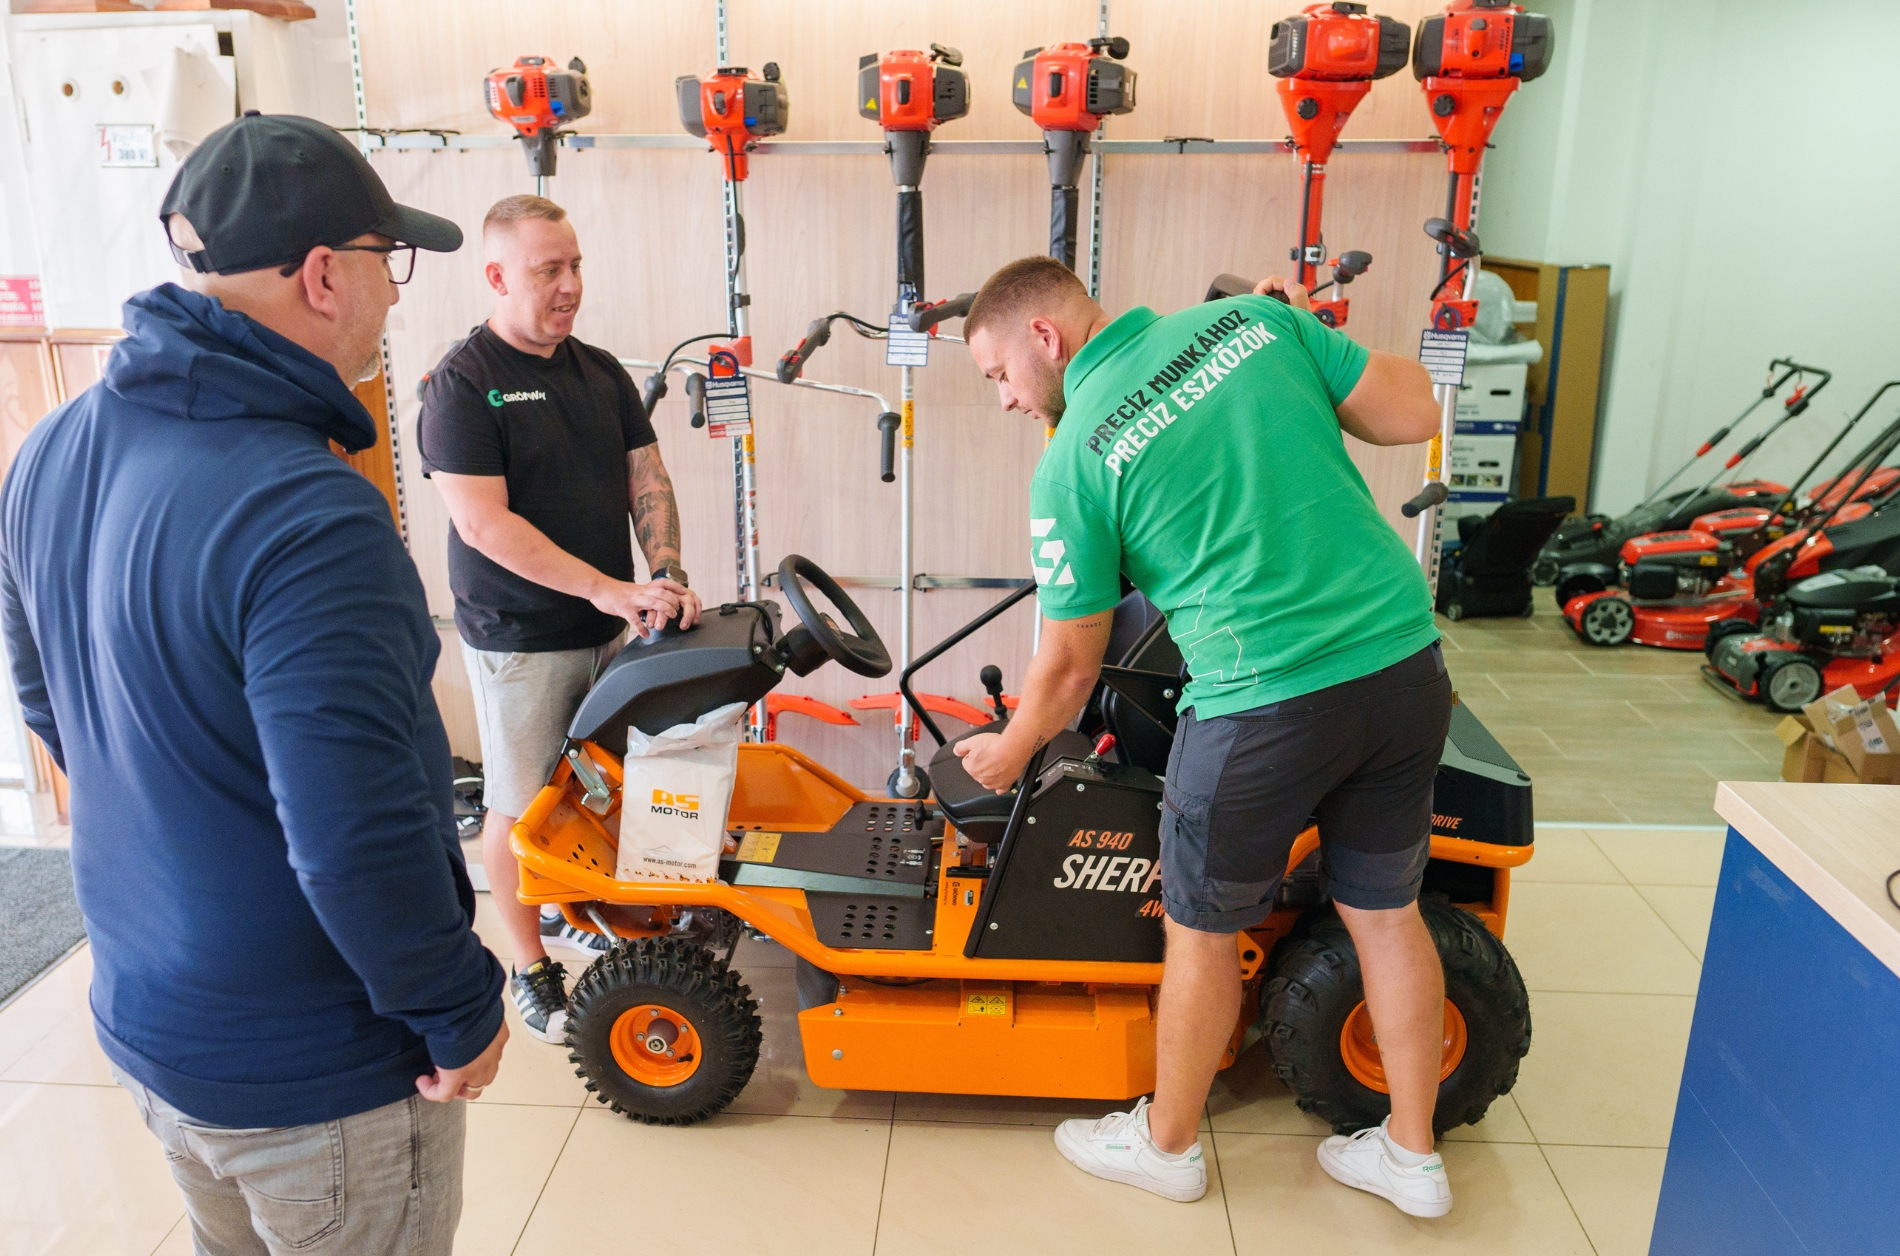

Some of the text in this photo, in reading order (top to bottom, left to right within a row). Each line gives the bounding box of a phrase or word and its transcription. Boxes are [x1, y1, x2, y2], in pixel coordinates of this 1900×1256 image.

[1432, 332, 1467, 341] Husqvarna
[713, 380, 746, 389] Husqvarna
[1086, 309, 1250, 456] PRECÍZ MUNKÁHOZ
[1105, 321, 1277, 477] PRECÍZ ESZKÖZÖK
[651, 788, 700, 811] AS
[650, 806, 699, 820] MOTOR
[1069, 829, 1134, 850] AS 940
[643, 857, 697, 869] www.as-motor.com
[1422, 1162, 1443, 1173] Reebo
